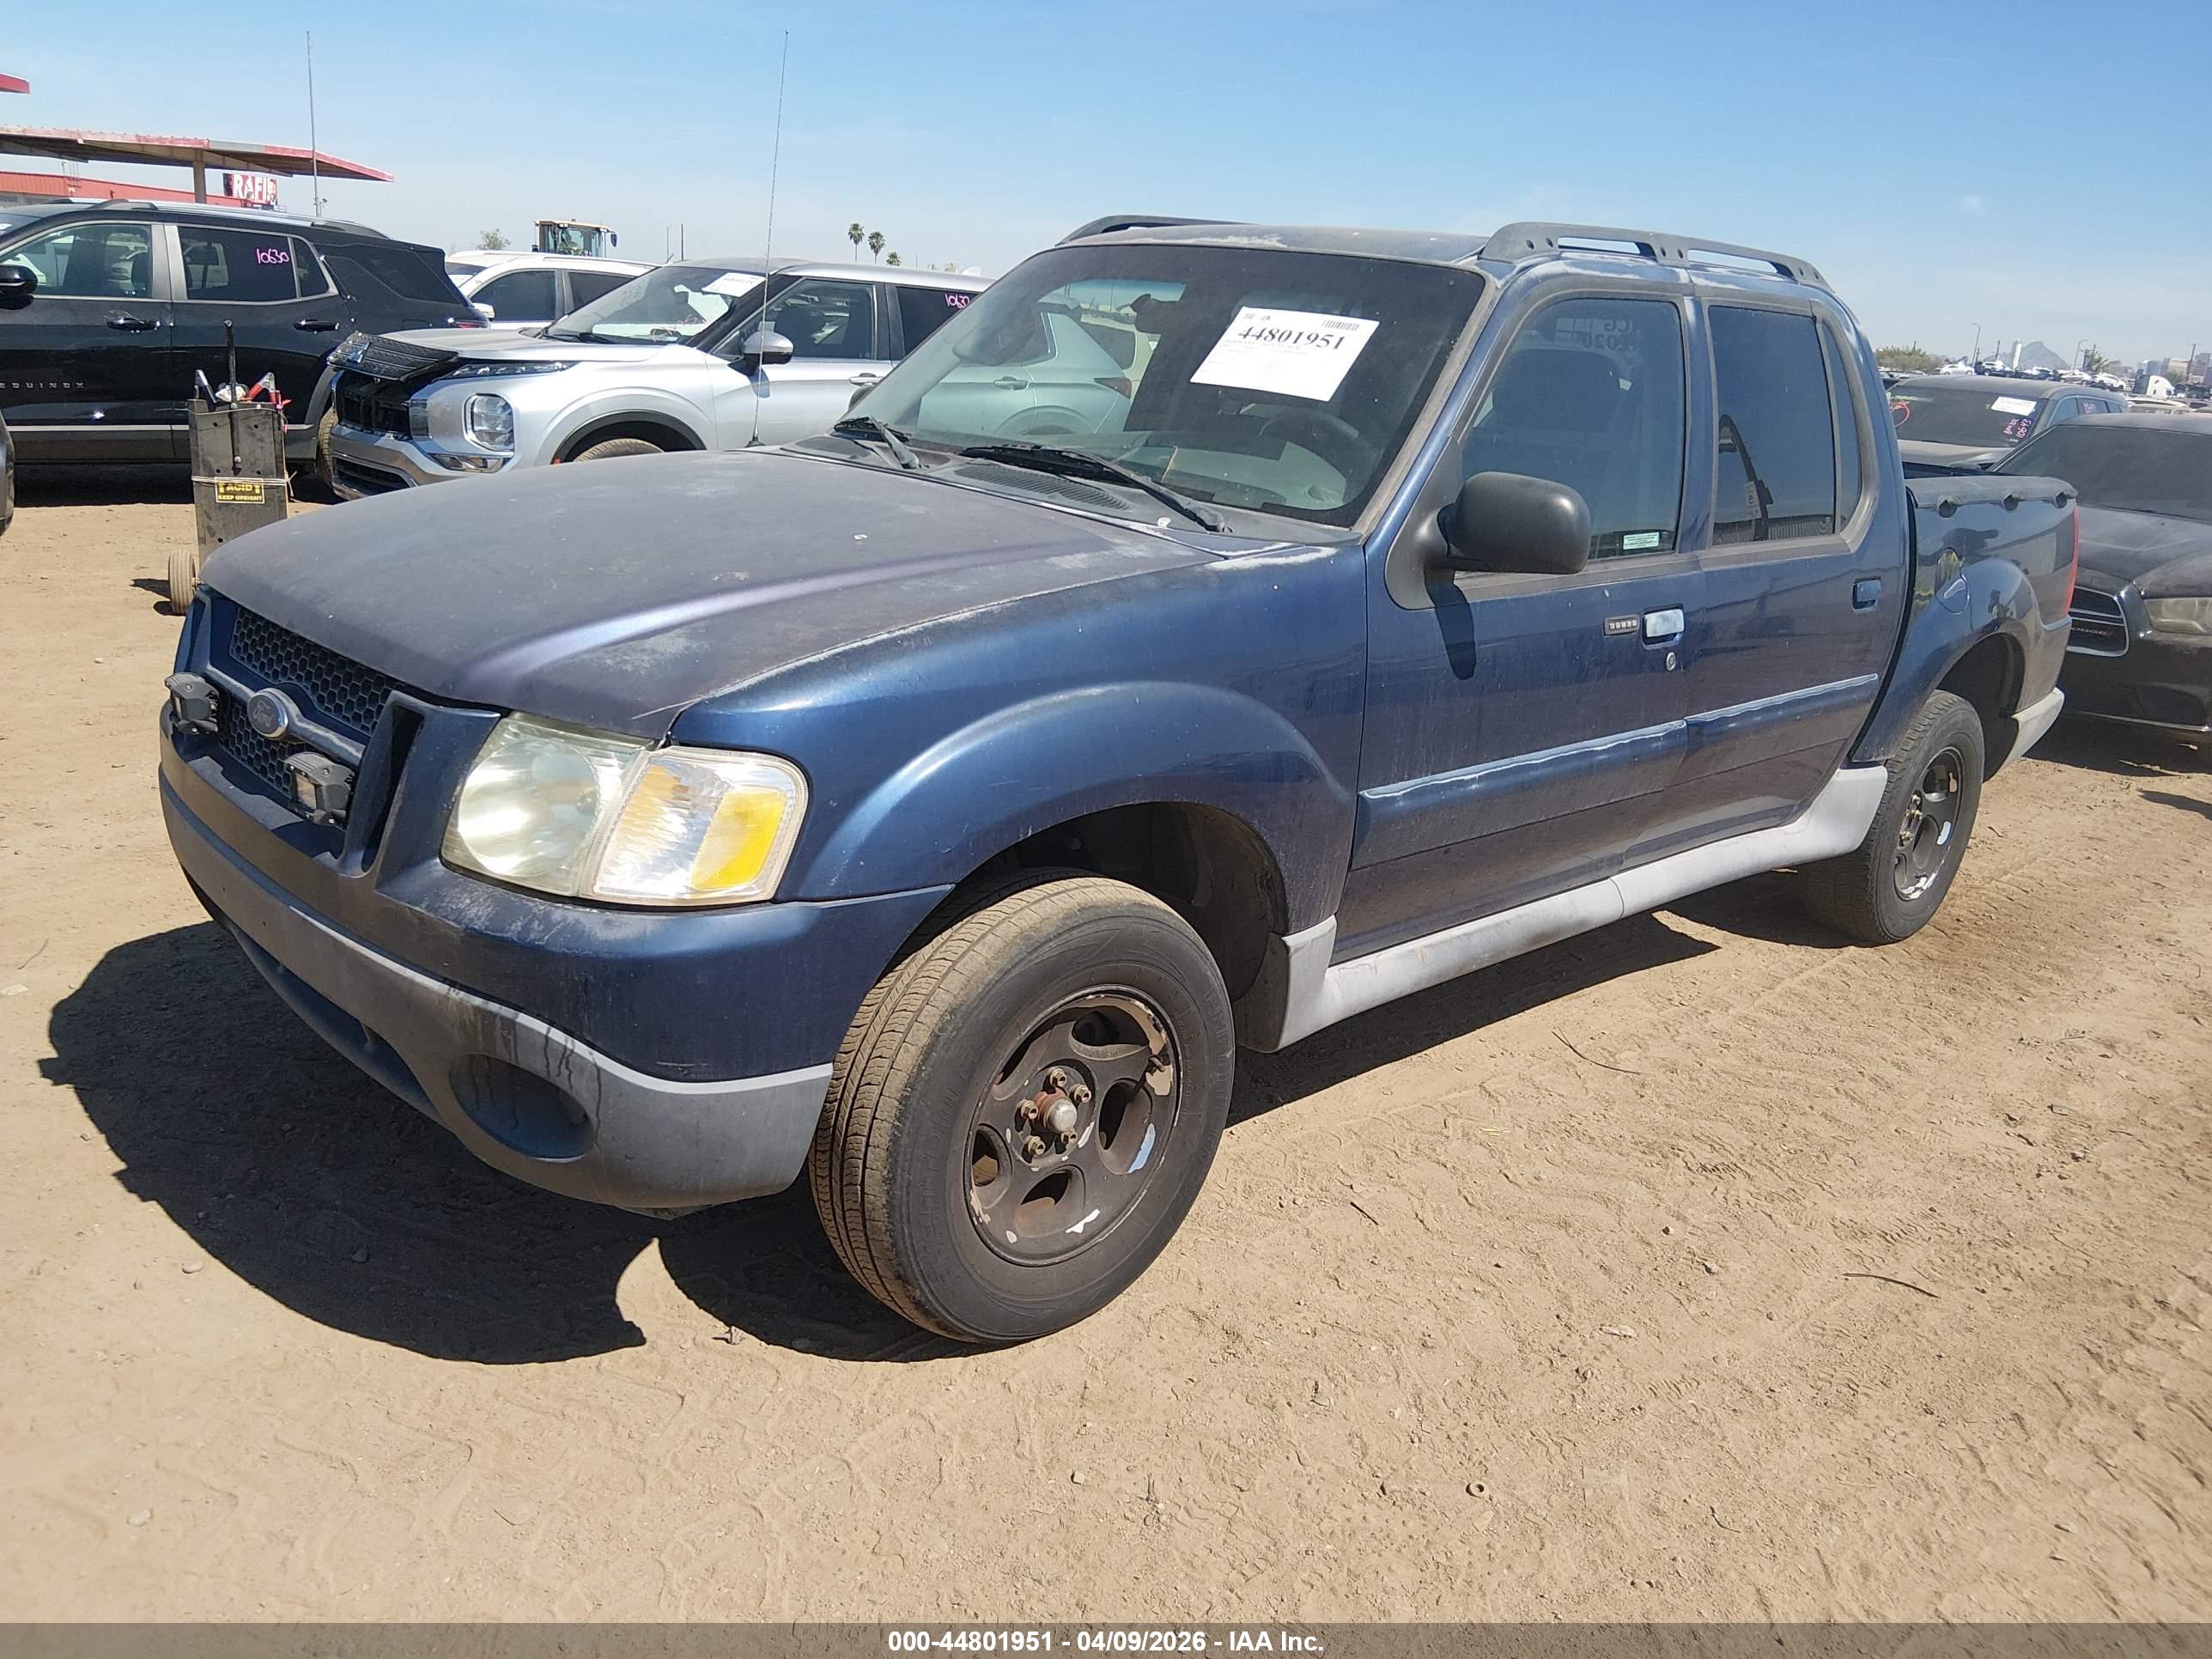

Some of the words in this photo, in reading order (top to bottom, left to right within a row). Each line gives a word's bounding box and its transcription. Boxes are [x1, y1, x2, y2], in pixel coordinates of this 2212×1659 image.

[257, 248, 289, 264] 10630
[1237, 325, 1345, 350] 44801951
[227, 483, 253, 491] ACID
